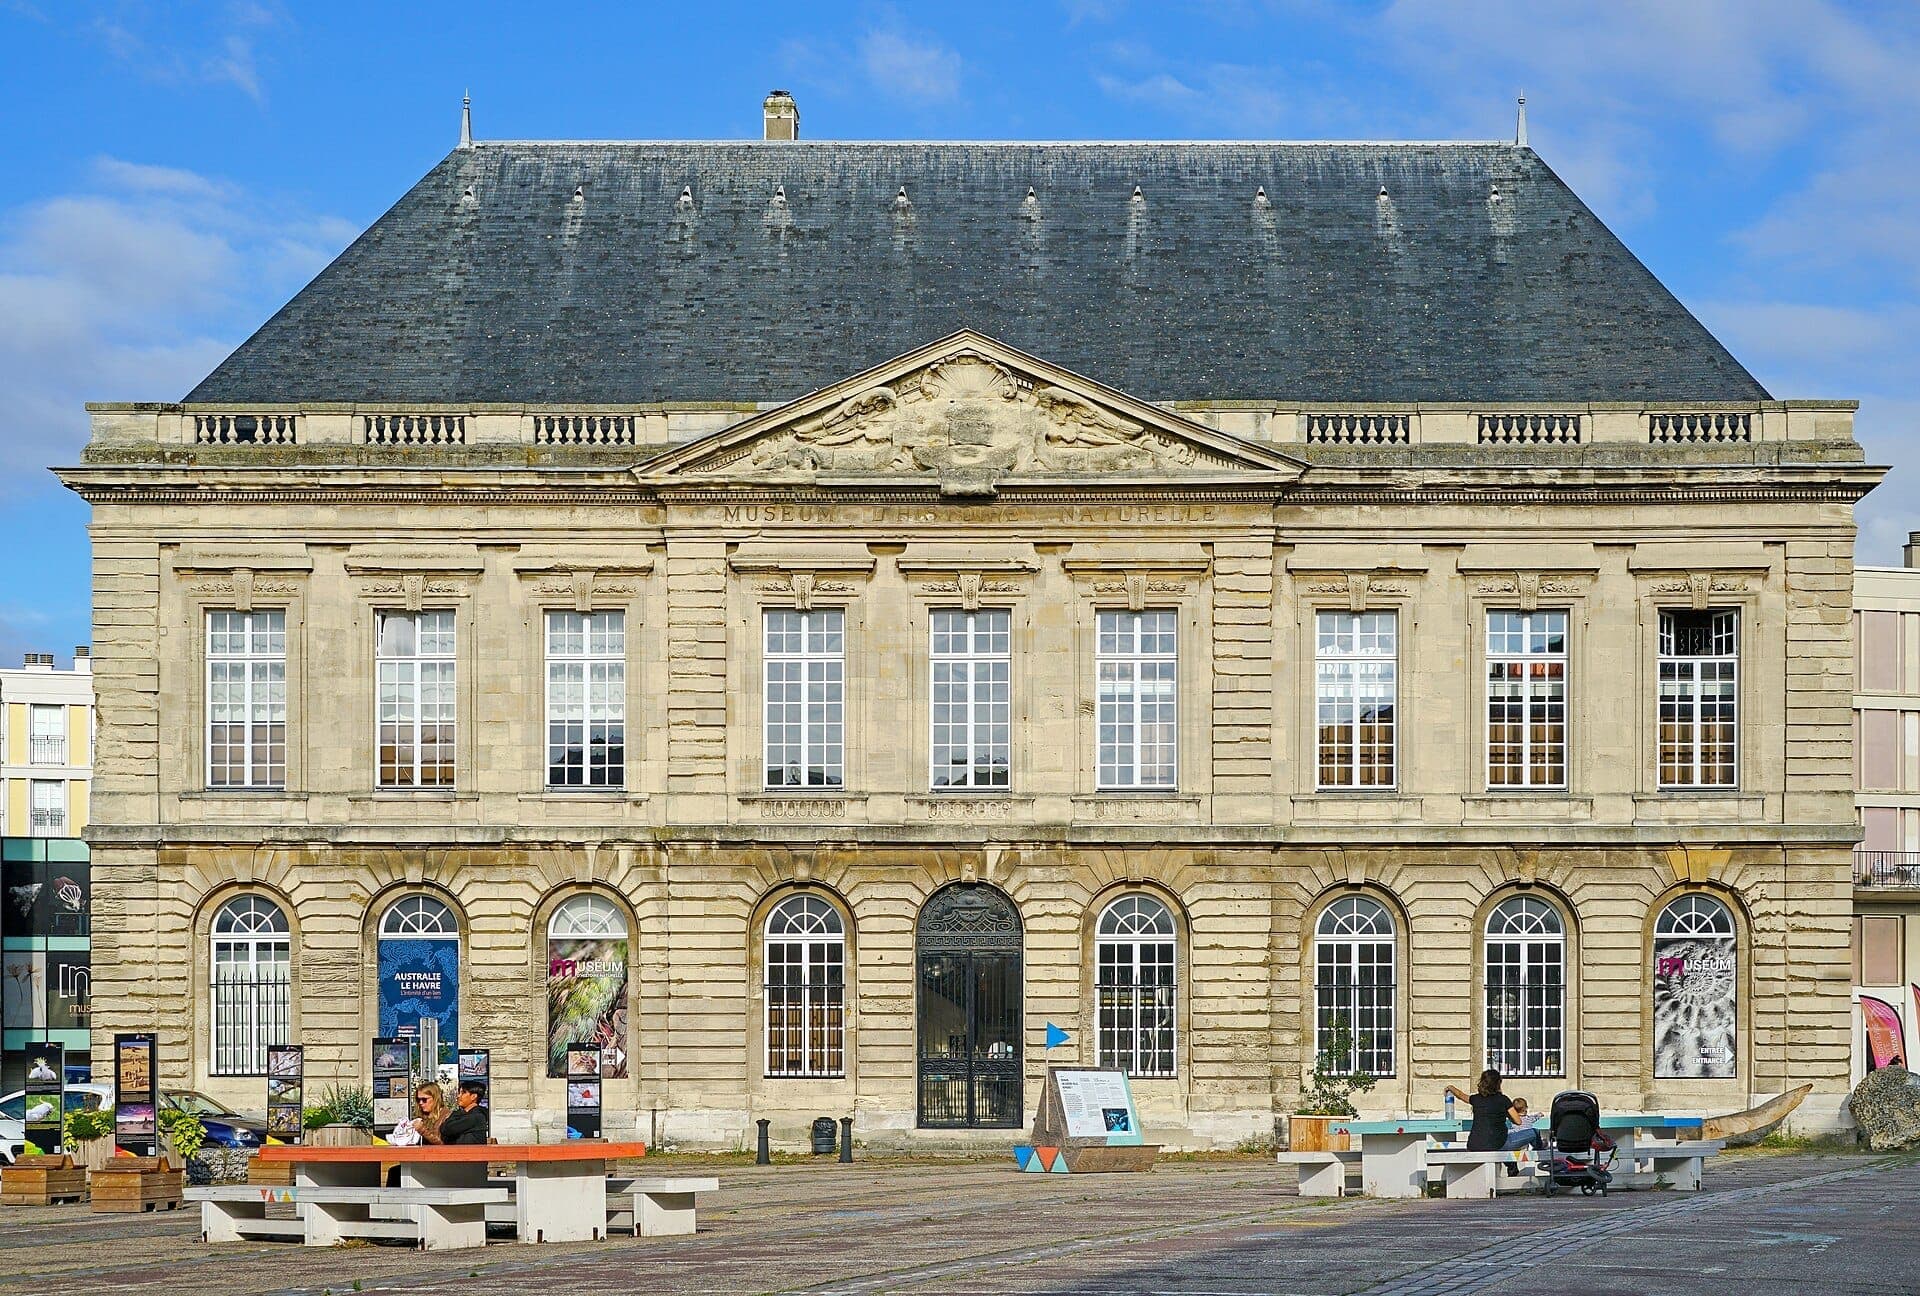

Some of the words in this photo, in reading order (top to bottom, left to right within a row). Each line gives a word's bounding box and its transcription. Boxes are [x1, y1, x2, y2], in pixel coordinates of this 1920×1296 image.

[723, 505, 836, 523] MUSEUM
[1058, 504, 1217, 523] NATURELLE
[394, 972, 441, 981] AUSTRALIE
[400, 981, 411, 990] LE
[412, 981, 441, 990] HAVRE
